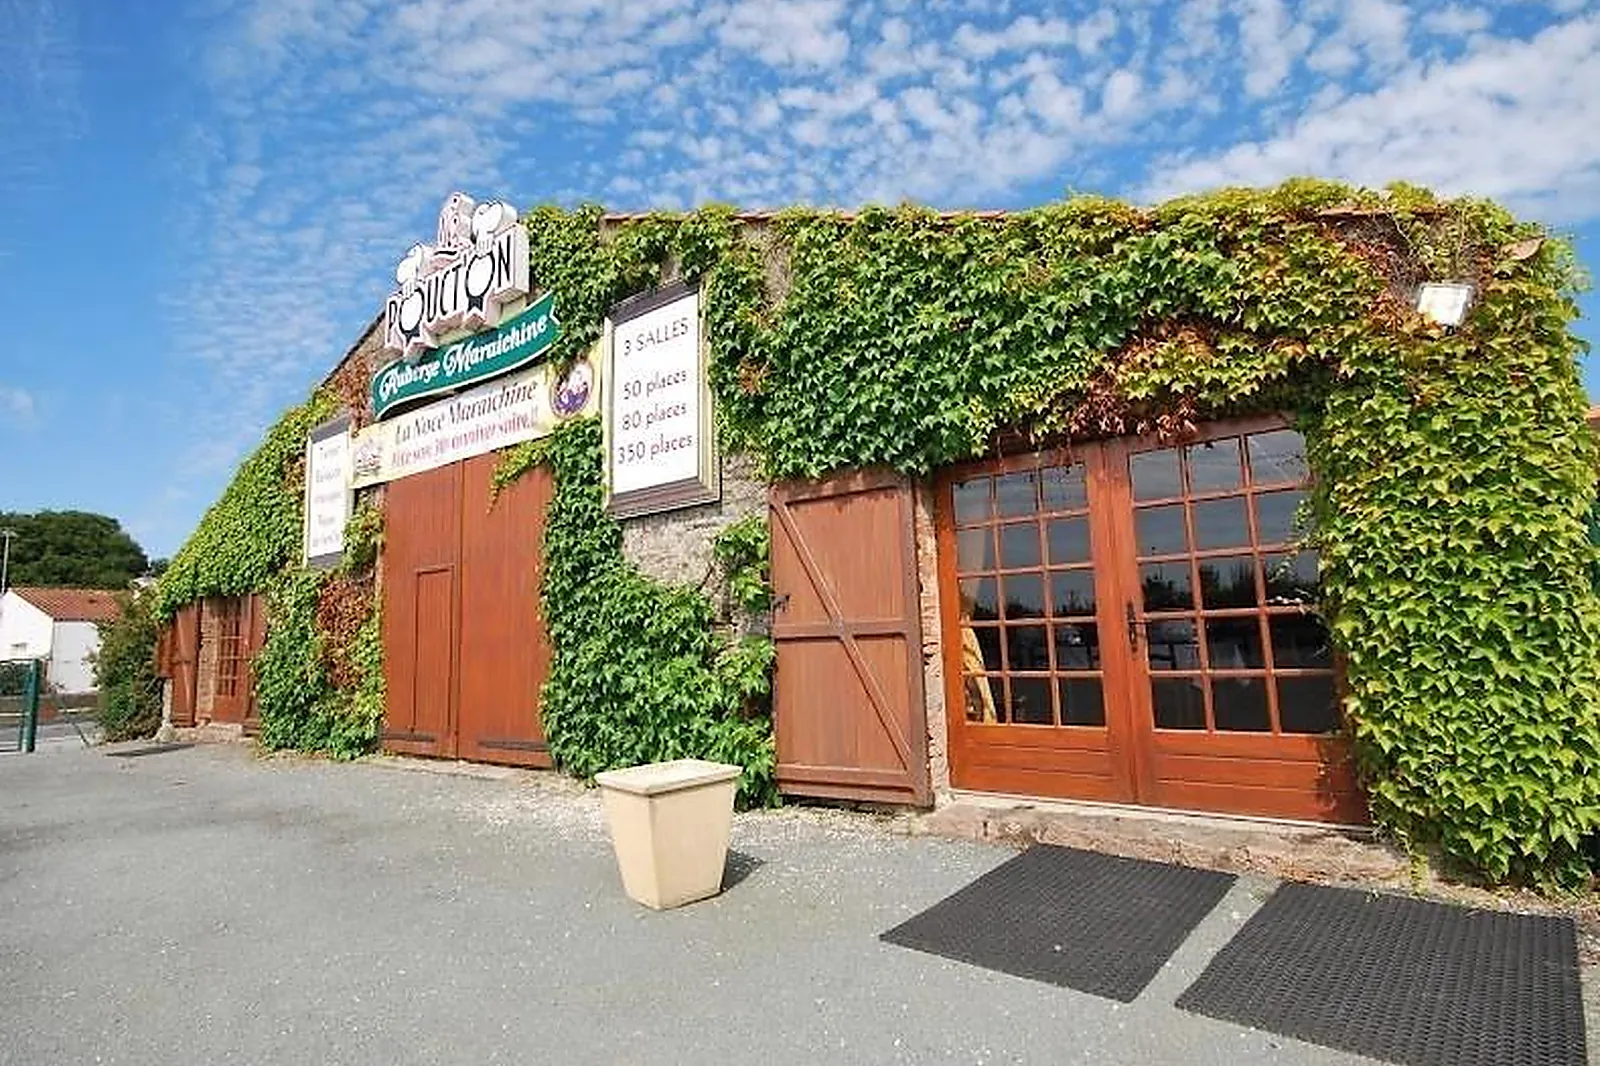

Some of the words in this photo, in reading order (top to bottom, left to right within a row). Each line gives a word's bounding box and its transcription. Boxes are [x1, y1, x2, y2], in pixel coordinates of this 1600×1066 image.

[623, 339, 632, 356] 3
[636, 317, 689, 351] SALLES
[378, 359, 440, 402] Auberge
[623, 379, 642, 400] 50
[646, 370, 687, 397] places
[622, 410, 642, 431] 80
[646, 402, 687, 428] places
[617, 440, 646, 464] 350
[650, 433, 693, 460] places
